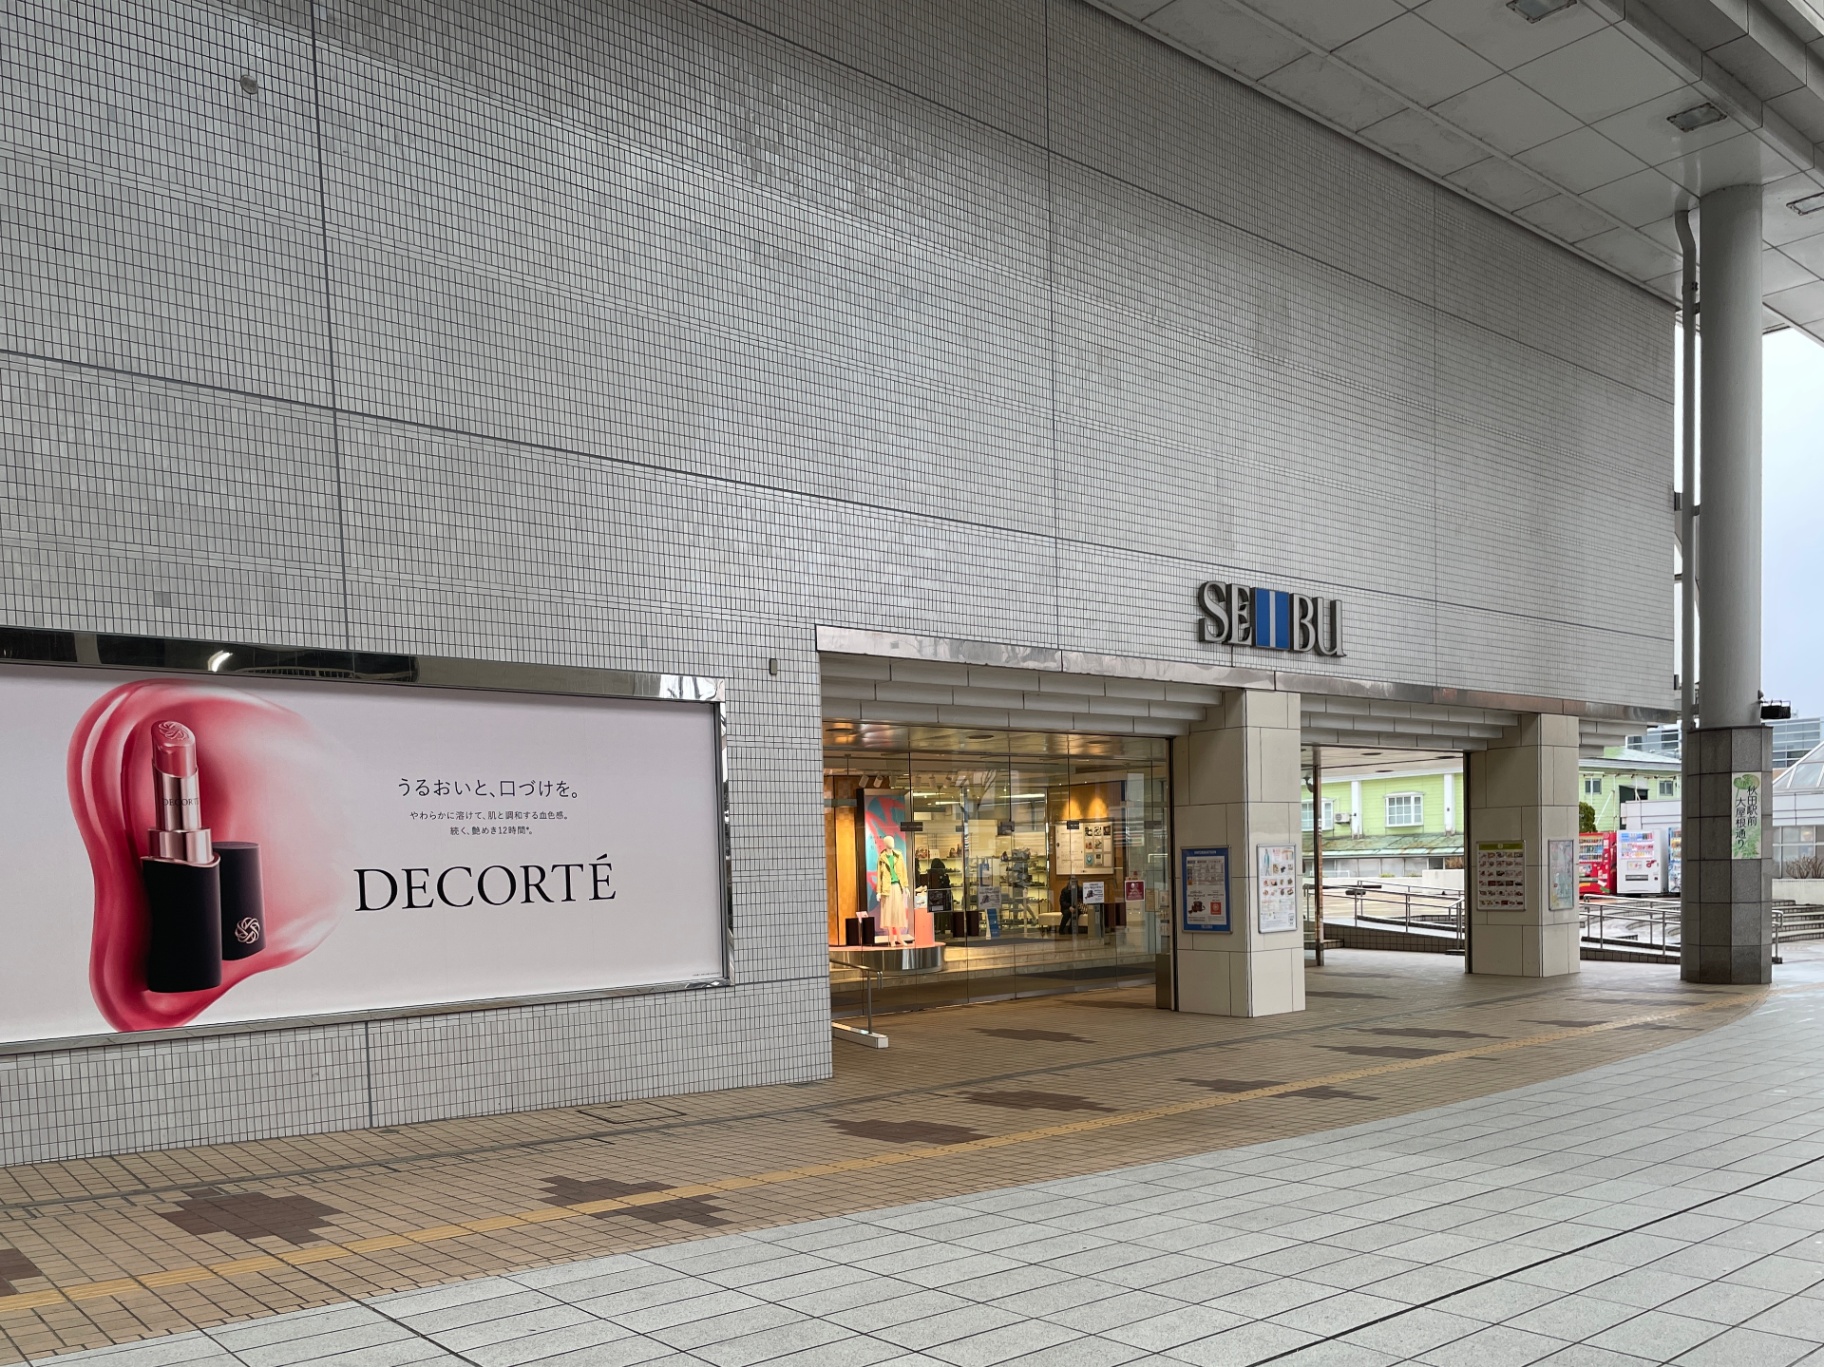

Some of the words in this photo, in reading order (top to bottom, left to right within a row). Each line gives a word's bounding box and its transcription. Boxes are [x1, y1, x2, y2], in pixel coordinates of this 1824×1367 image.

[1198, 580, 1347, 657] SEIBU
[398, 778, 578, 799] うるおいと、口づけを。
[1747, 785, 1758, 827] 秋田駅前
[409, 810, 568, 821] やわらかに溶けて、肌と調和する血色感。
[1735, 796, 1747, 850] 大屋根通り
[353, 853, 617, 912] DECORTÉ
